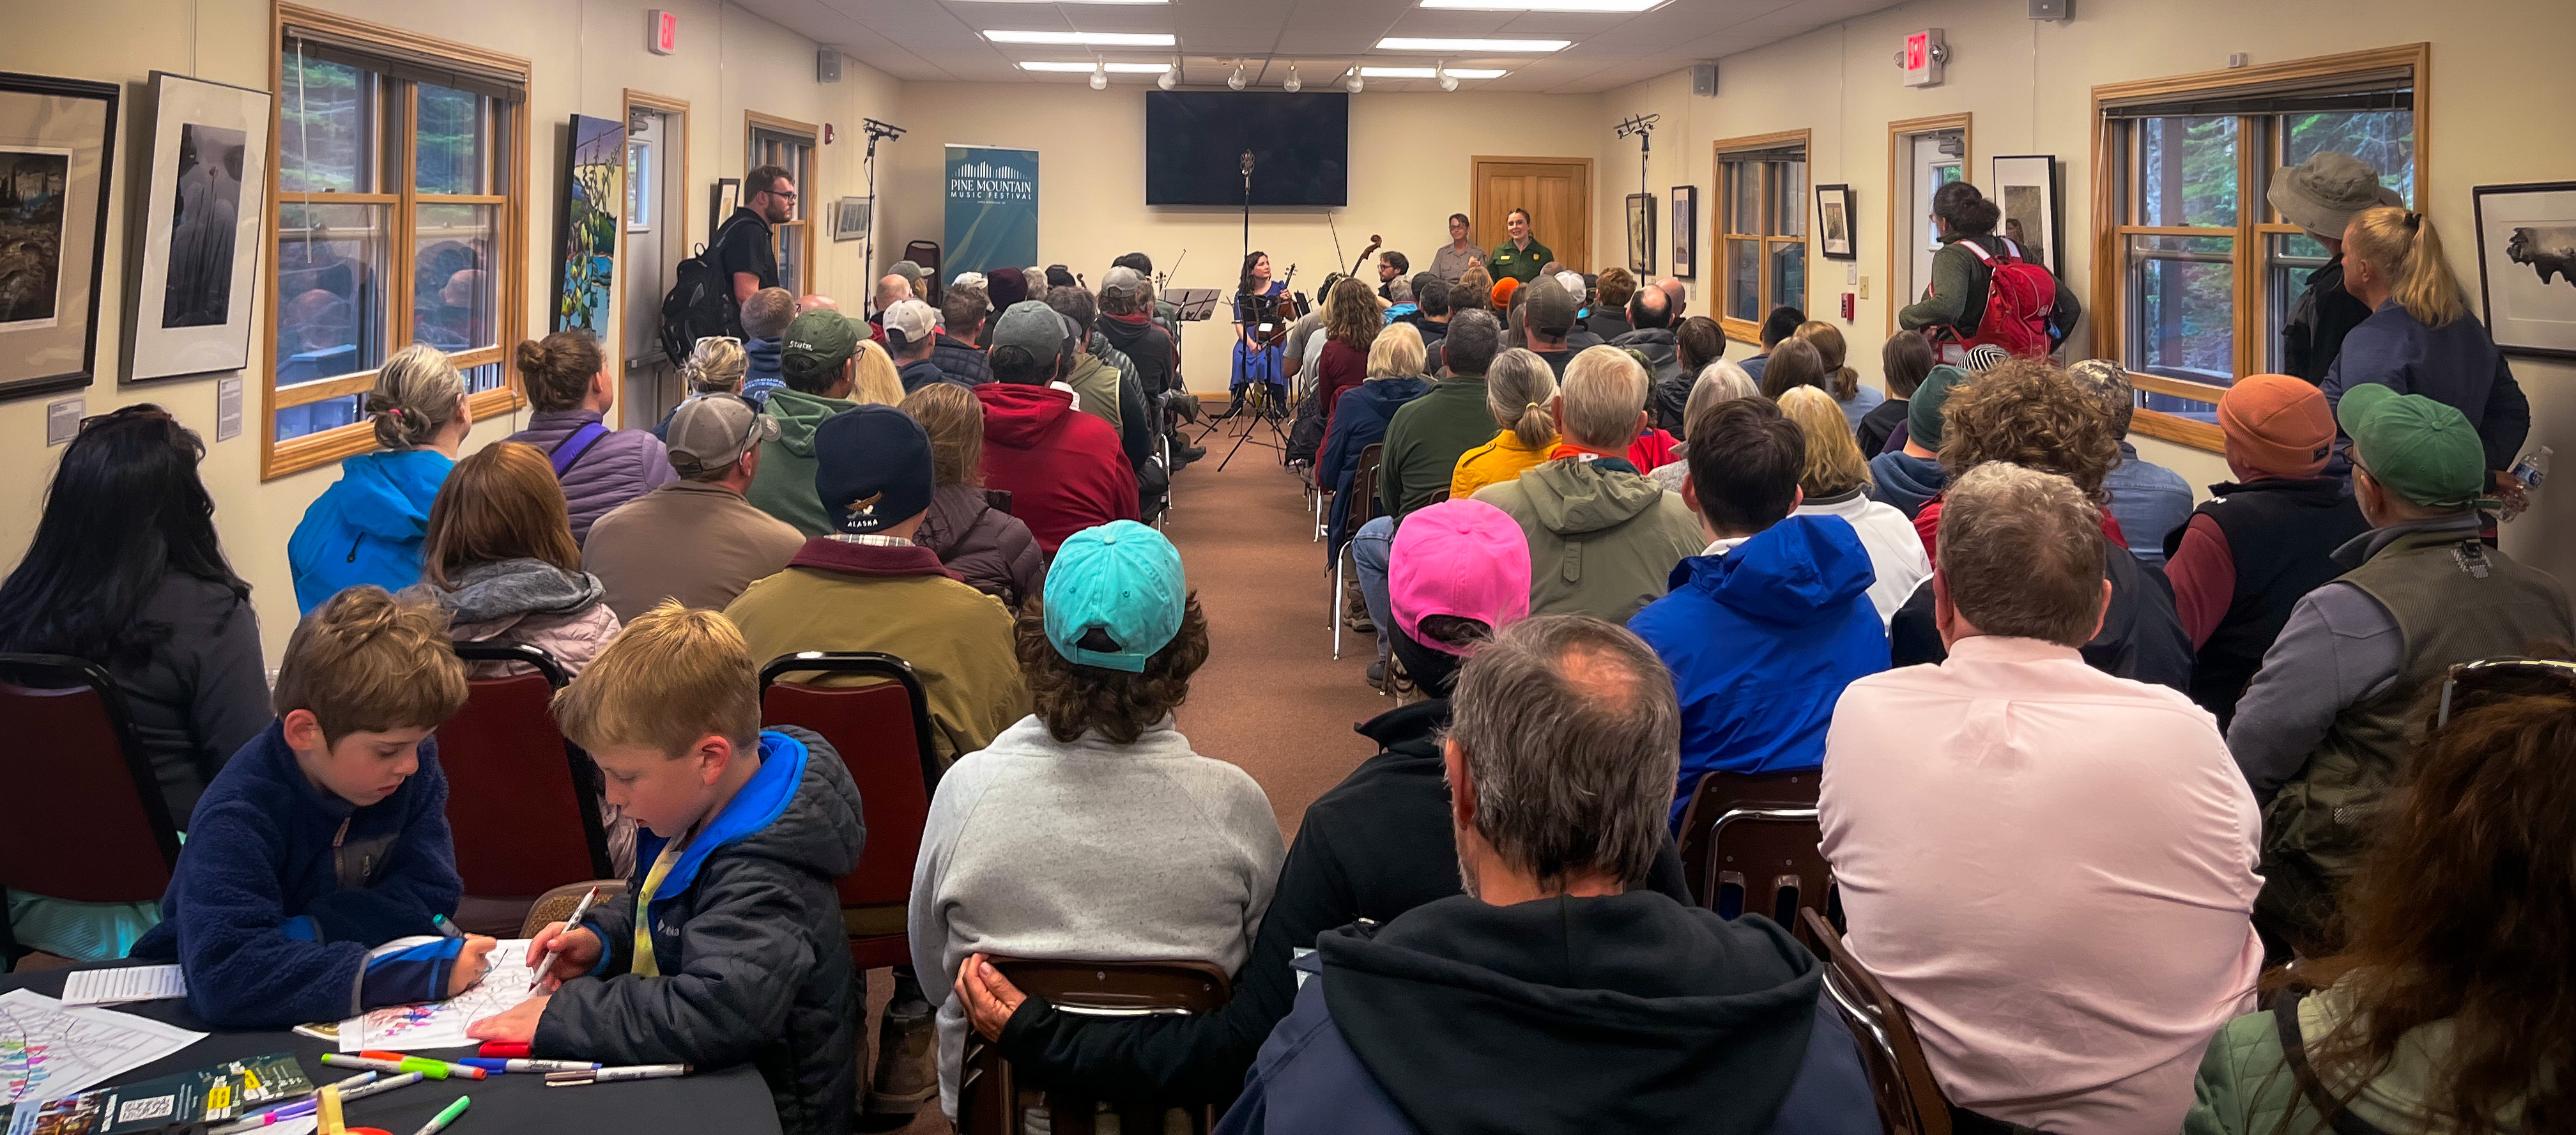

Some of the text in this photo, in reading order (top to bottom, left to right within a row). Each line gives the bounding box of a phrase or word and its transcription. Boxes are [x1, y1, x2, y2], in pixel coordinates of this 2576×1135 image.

[951, 179, 1031, 193] PINE MOUNTAIN
[988, 192, 1031, 200] FESTIVAL
[847, 518, 878, 528] ALASKA
